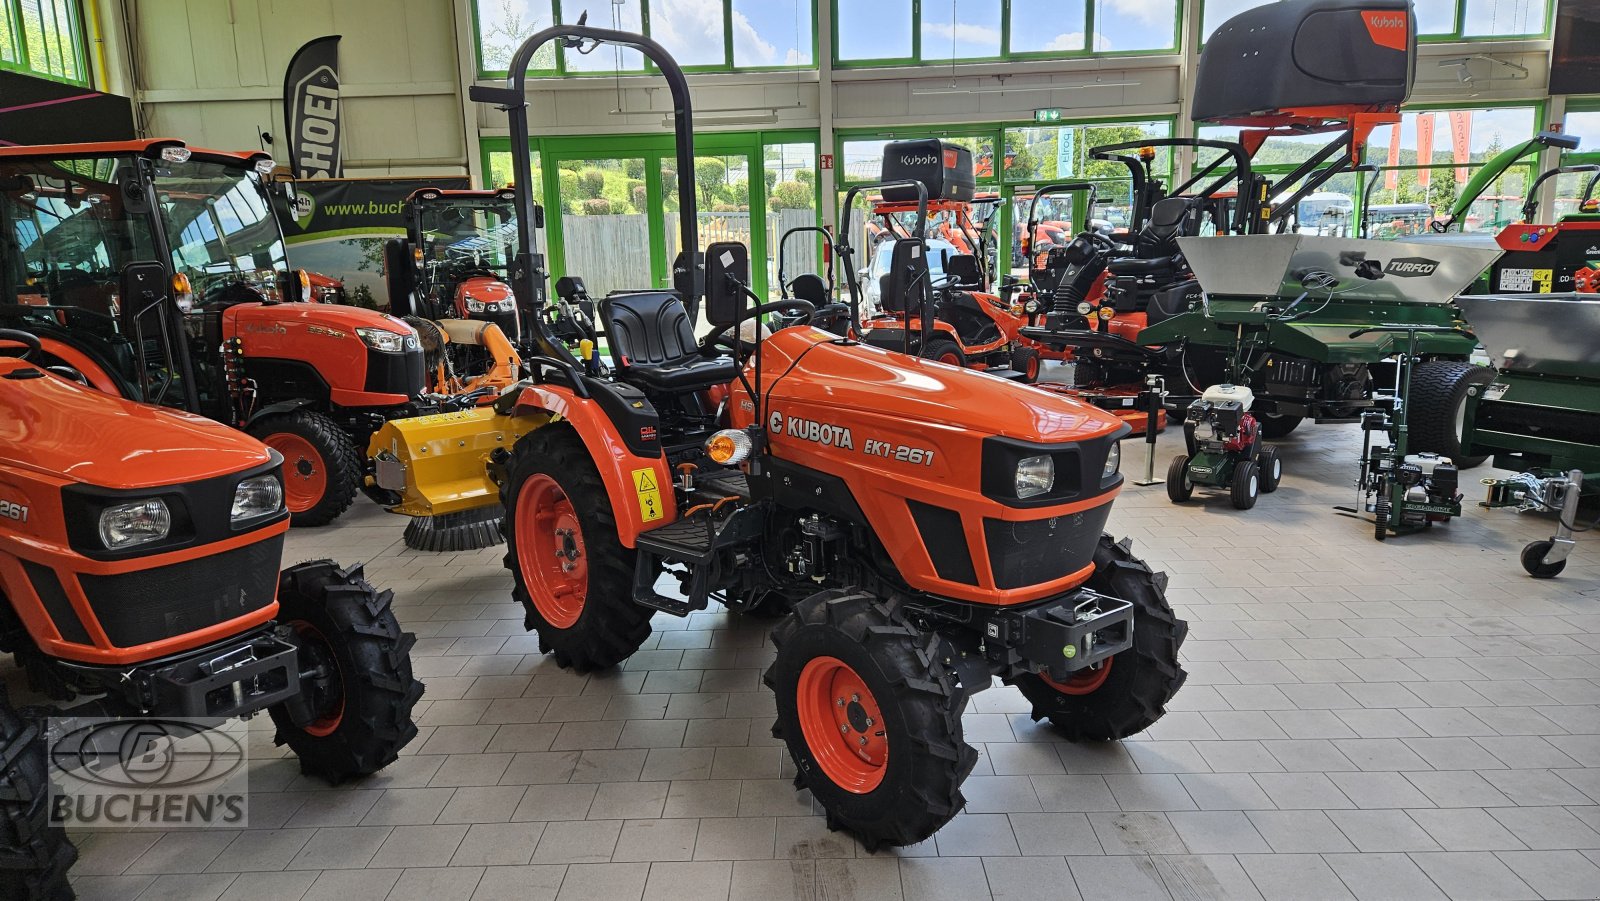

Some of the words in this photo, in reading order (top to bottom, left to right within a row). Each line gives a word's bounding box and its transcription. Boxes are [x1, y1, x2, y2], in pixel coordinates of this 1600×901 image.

[1371, 16, 1404, 28] Kubota
[900, 154, 938, 165] Kubota
[1390, 261, 1435, 274] TURFCO
[787, 416, 854, 450] KUBOTA
[863, 439, 935, 466] EK1-261
